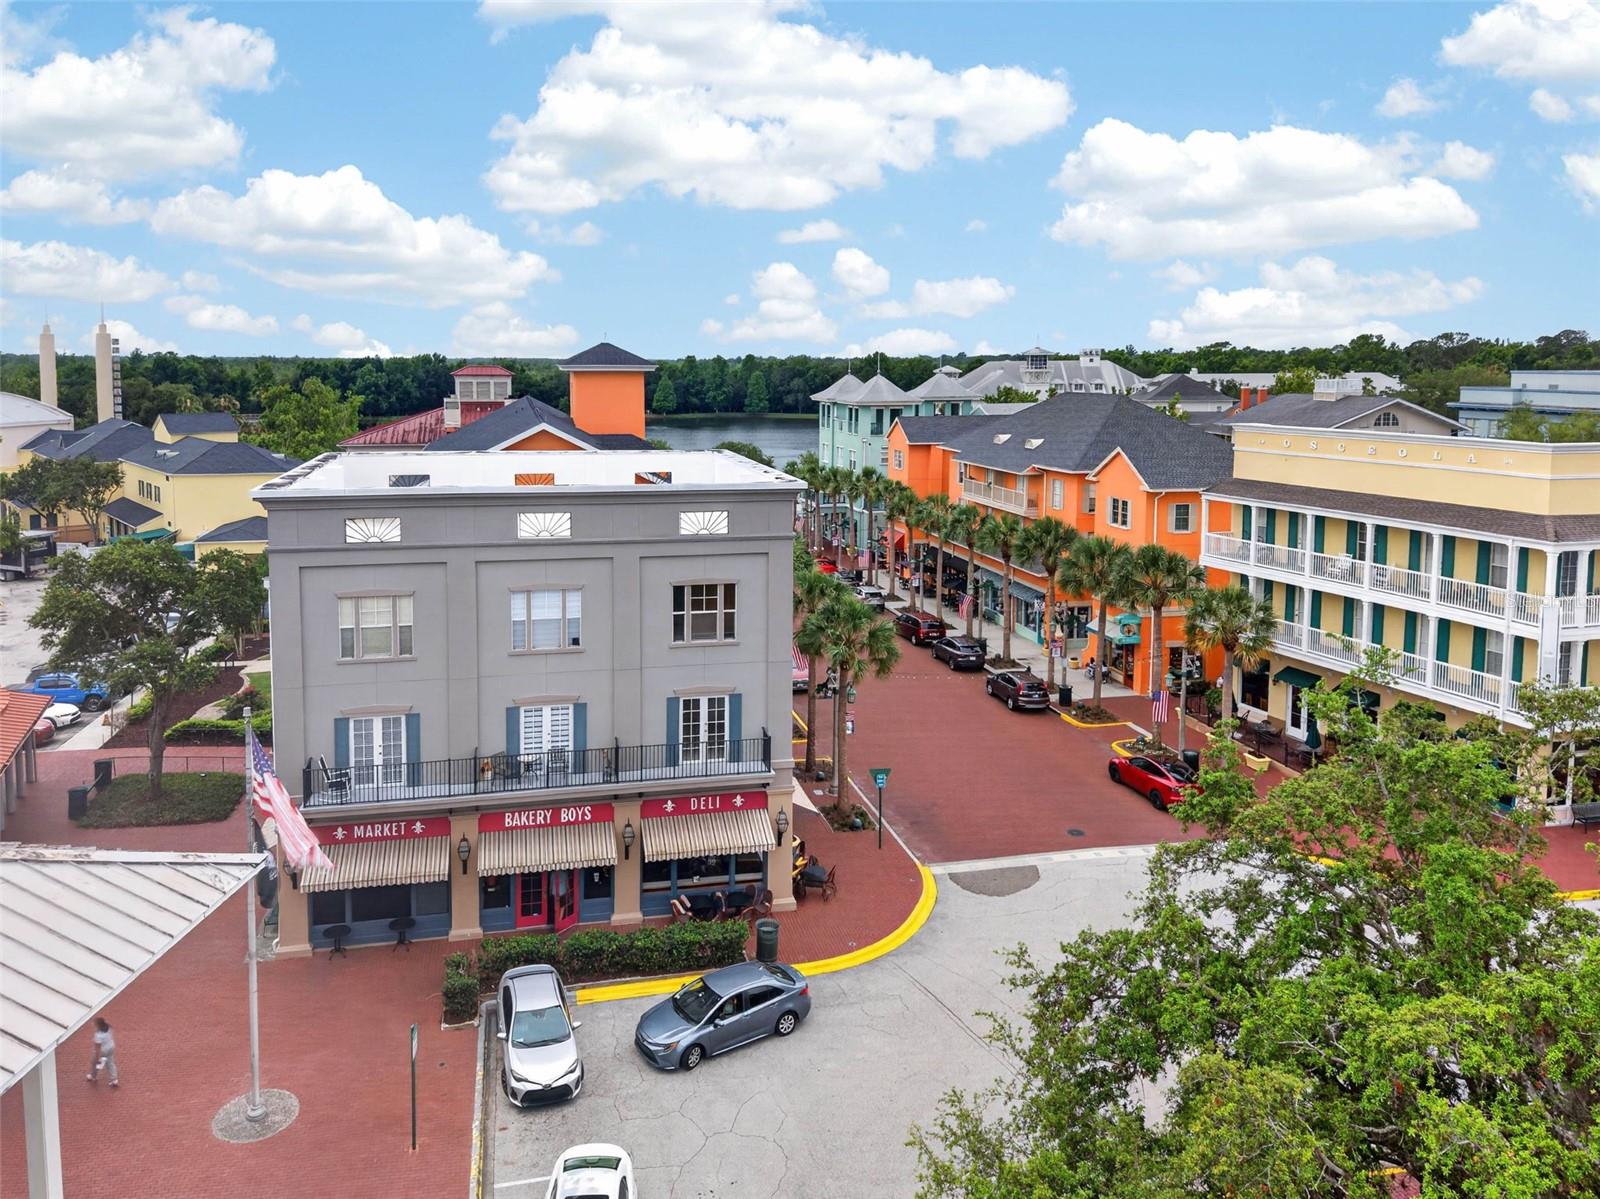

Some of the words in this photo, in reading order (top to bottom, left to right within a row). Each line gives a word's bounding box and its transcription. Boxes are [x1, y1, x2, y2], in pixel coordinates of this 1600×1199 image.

[690, 795, 721, 812] DELI
[504, 809, 552, 828] BAKERY
[560, 806, 592, 823] BOYS
[353, 822, 407, 839] MARKET
